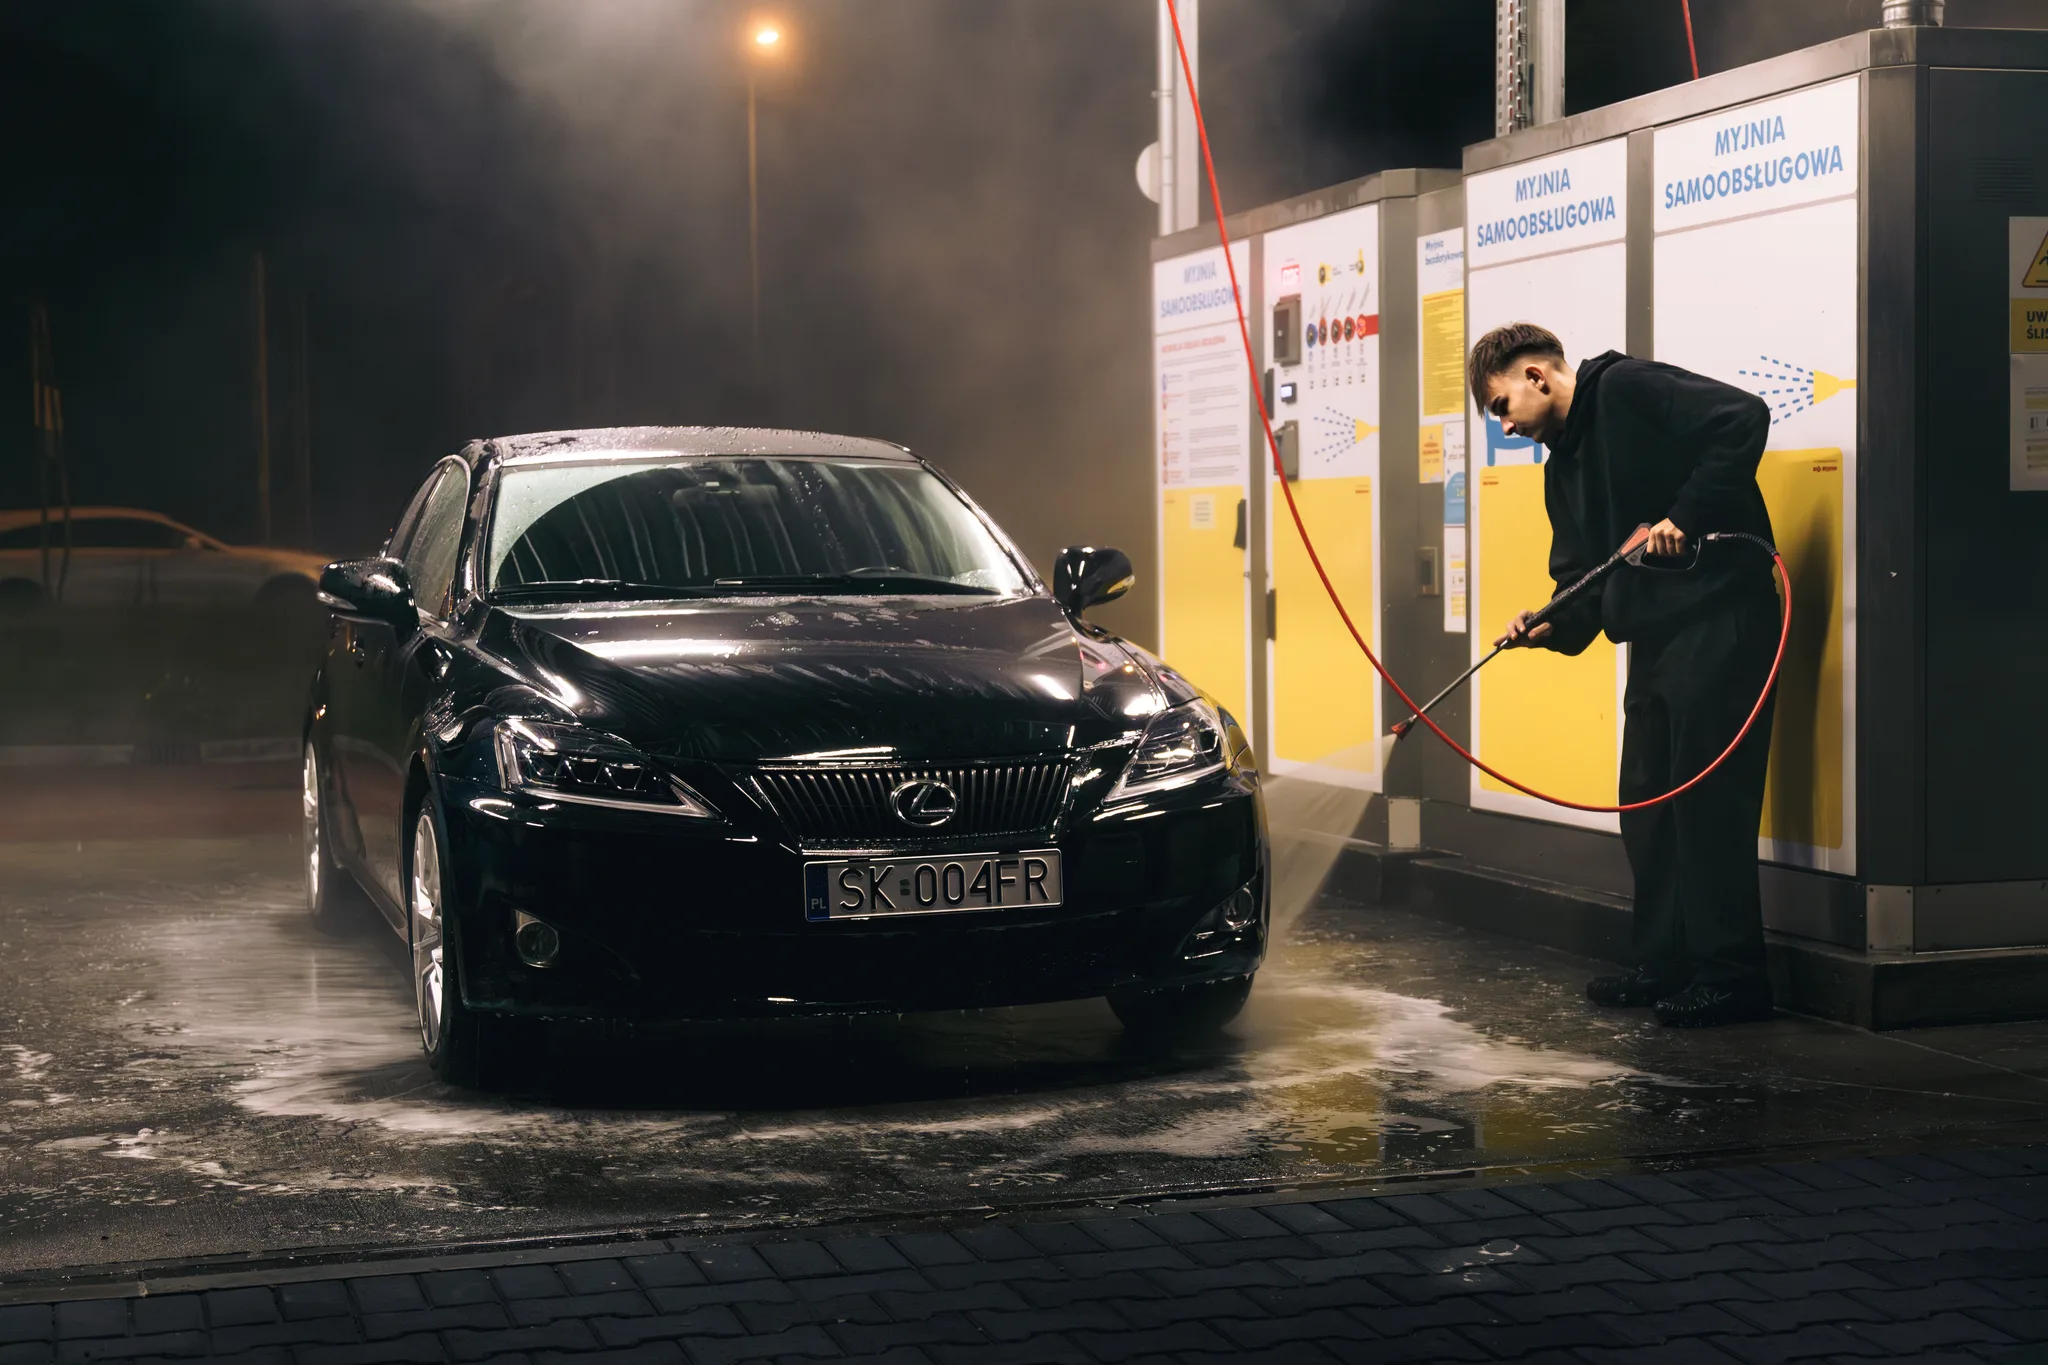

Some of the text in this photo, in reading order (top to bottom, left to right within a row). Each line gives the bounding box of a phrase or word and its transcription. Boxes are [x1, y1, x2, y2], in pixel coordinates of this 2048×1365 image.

[1714, 115, 1785, 156] MYJNIA
[1515, 168, 1571, 203] MYJNIA
[1664, 145, 1844, 210] SAMOOBSŁUGOWA
[1476, 195, 1616, 248] SAMOOBSŁUGOWA
[1183, 260, 1217, 285] MYJNIA
[2026, 310, 2048, 323] UW
[838, 857, 1051, 912] SK 004FR
[811, 898, 826, 910] PL
